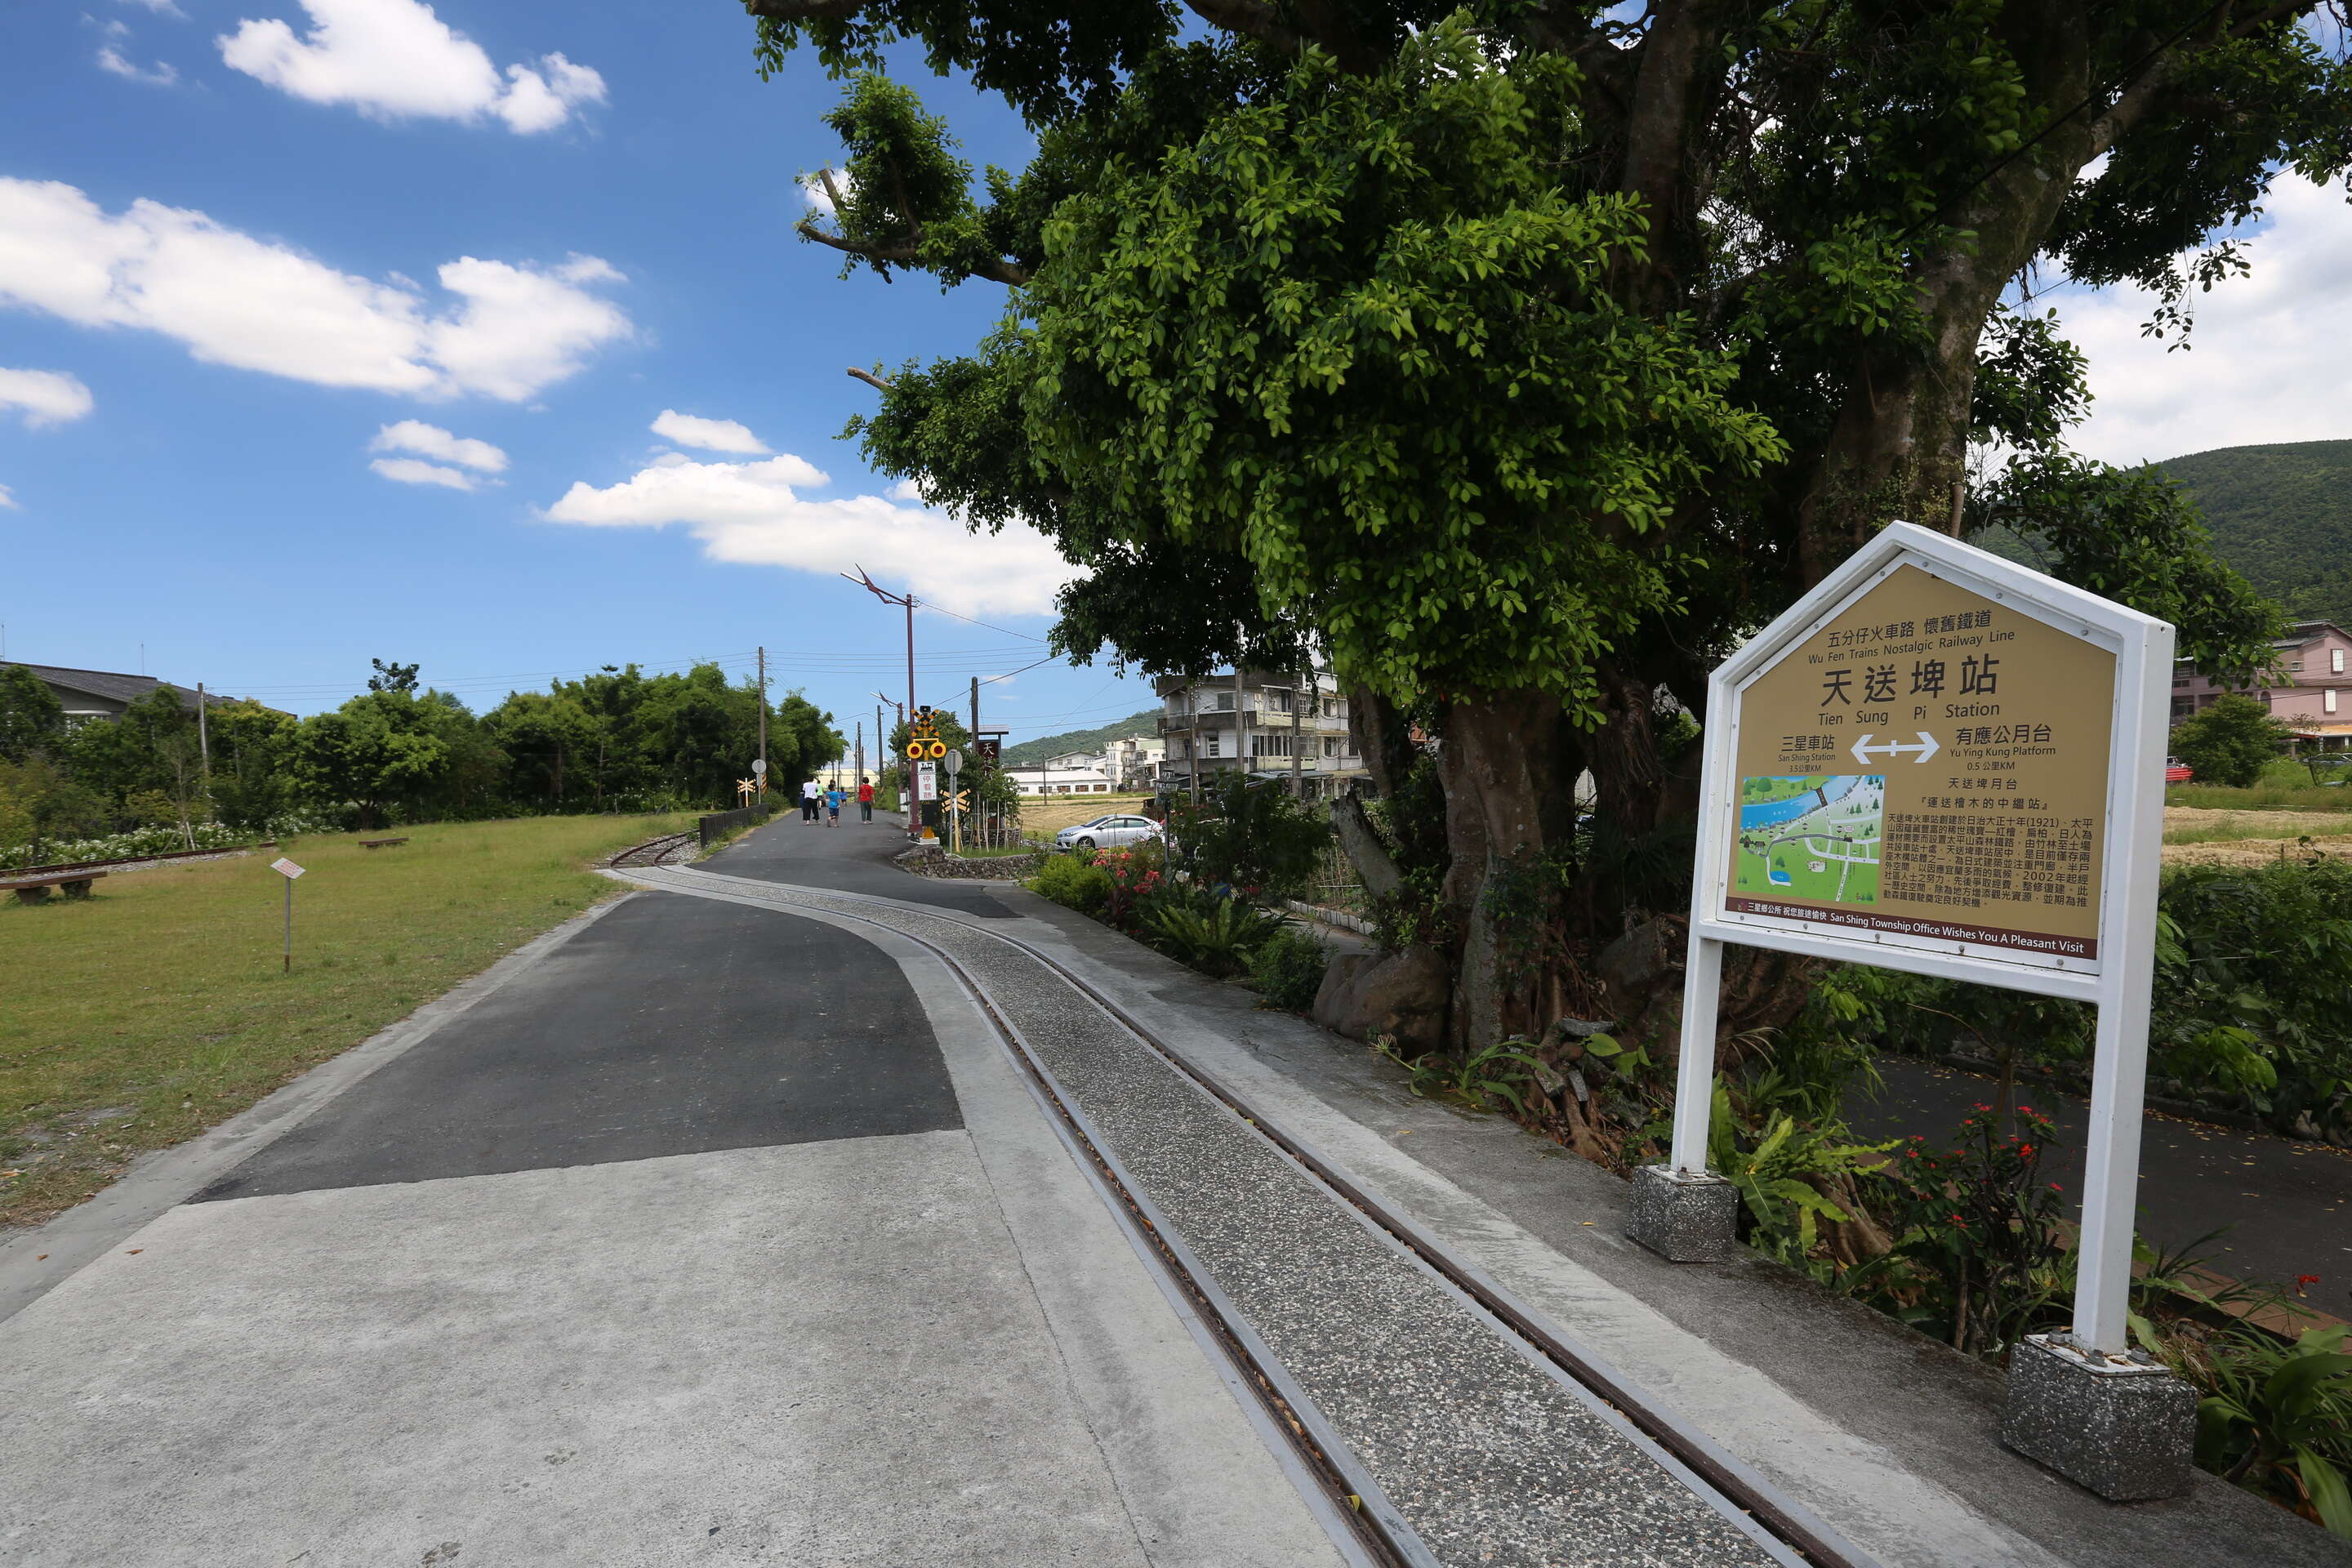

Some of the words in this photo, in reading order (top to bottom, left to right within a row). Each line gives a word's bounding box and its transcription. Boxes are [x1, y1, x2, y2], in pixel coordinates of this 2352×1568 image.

[1827, 621, 1915, 648] 五分仔火車路
[1924, 609, 1992, 635] 懷舊鐵道
[1809, 655, 1824, 665] Wu
[1829, 653, 1844, 662] Fen
[1850, 649, 1878, 659] Trains
[1884, 639, 1934, 656] Nostalgic
[1939, 635, 1984, 648] Railway
[1989, 630, 2015, 643] Line
[1821, 653, 2000, 707] 天送埤站
[1818, 712, 1843, 725] Tien
[1856, 710, 1889, 725] Sung
[1913, 705, 1926, 720] Pi
[1945, 702, 2000, 719] Station
[1781, 734, 1835, 751] 三星車站
[1955, 724, 2051, 746] 有應公月台
[1778, 754, 1790, 762] San
[1791, 753, 1810, 763] Shing
[1811, 753, 1836, 761] Station
[1949, 748, 1961, 757] Yu
[1963, 747, 1983, 759] Ying
[1985, 747, 2010, 758] Kung
[2013, 746, 2056, 755] Platform
[1967, 762, 1980, 771] 0.5
[1983, 762, 2015, 771] 公里KM
[1948, 777, 2017, 790] 天送埤月台
[1748, 902, 1781, 915] 三星鄉公所
[1783, 906, 1828, 920] 祝您旅途愉快
[1830, 913, 1844, 922] San
[1846, 915, 1869, 928] Shing
[1870, 918, 1911, 933] Township
[1913, 922, 1940, 935] Office
[1942, 926, 1976, 939] Wishes
[1979, 931, 1998, 942] You
[2000, 934, 2008, 943] A
[2011, 934, 2056, 950] Pleasant
[2059, 941, 2084, 953] Visit
